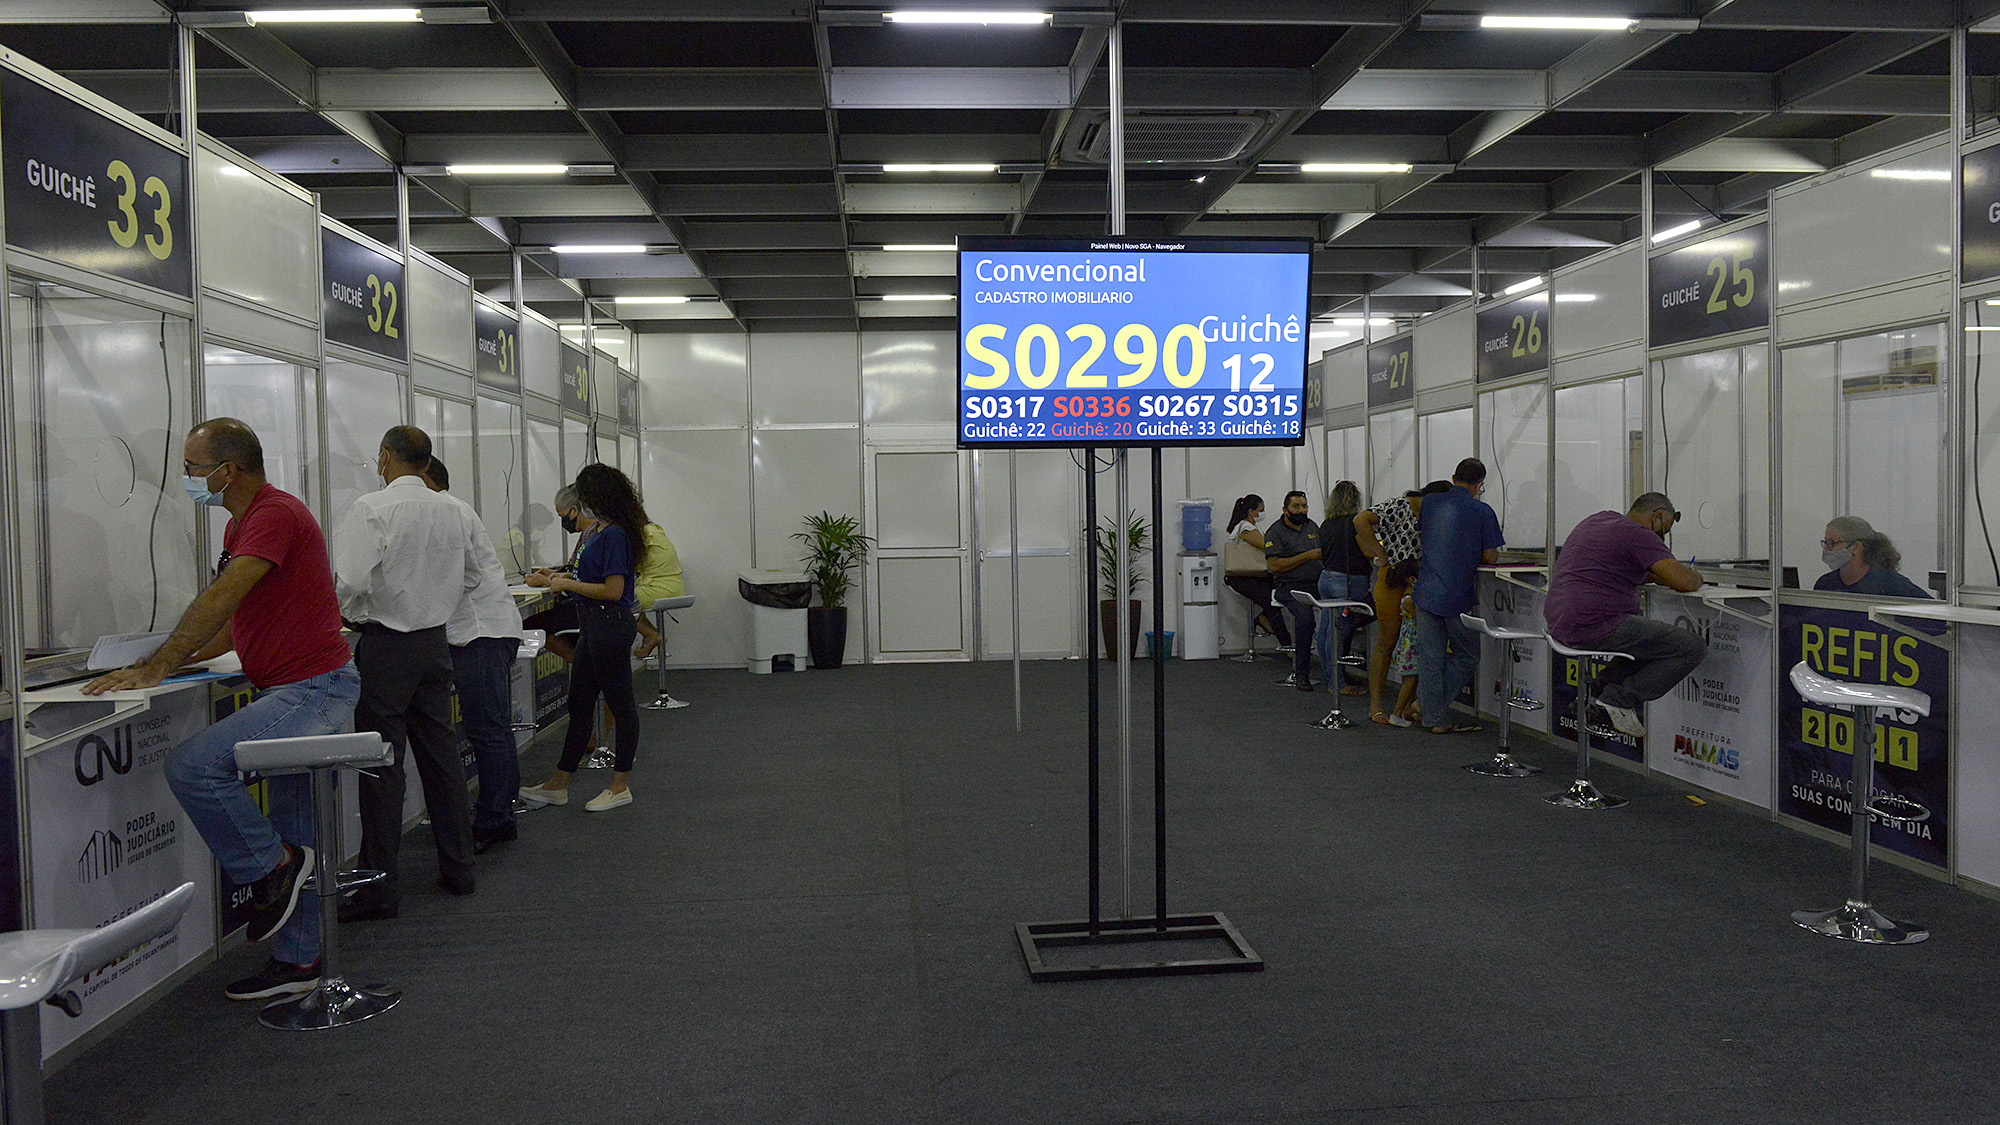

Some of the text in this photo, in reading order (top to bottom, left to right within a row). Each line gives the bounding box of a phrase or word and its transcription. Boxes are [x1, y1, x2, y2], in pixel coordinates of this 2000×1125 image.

[27, 158, 173, 260] GUICHÊ 33
[1156, 243, 1185, 251] Navegador
[975, 259, 1145, 282] Convencional
[1662, 246, 1754, 314] GUICHÊ 25
[332, 274, 398, 339] GUICHÊ 32
[975, 291, 1133, 304] CADASTRO IMOBILIARIO
[1198, 314, 1301, 343] Guichê
[1485, 310, 1541, 358] GUICHÊ 26
[498, 329, 514, 376] 31
[964, 323, 1207, 390] S0290
[1222, 353, 1275, 392] 12
[1390, 351, 1408, 389] 27
[576, 365, 588, 402] 30
[1307, 378, 1321, 408] 28
[965, 396, 1044, 418] S0317
[1053, 396, 1131, 418] S0336
[1138, 395, 1215, 417] S0267
[1223, 394, 1298, 416] S0315
[964, 422, 1046, 438] Guichê: 22
[1051, 422, 1132, 437] Guichê: 20
[1136, 421, 1216, 437] Guichê: 33
[1220, 420, 1299, 436] Guichê: 18
[1802, 623, 1920, 686] REFIS
[1703, 679, 1724, 690] PODER
[1702, 689, 1740, 705] JUDICIÁRIO
[137, 715, 171, 734] CONSELHO
[1560, 716, 1578, 730] SUAS
[1623, 735, 1637, 747] DIA
[1681, 725, 1731, 745] PREFEITURA
[137, 731, 170, 749] NACIONAL
[1807, 714, 1911, 763] 201
[138, 754, 147, 767] DE
[1674, 734, 1740, 770] PALMAS
[1812, 770, 1842, 791] PARA
[126, 811, 156, 835] PODER
[1792, 785, 1823, 805] SUAS
[1827, 795, 1877, 823] CONS
[1907, 821, 1932, 840] DIA
[127, 820, 175, 852] JUDICIÁRIO
[231, 885, 253, 908] SUA
[88, 977, 110, 995] CAPITAL
